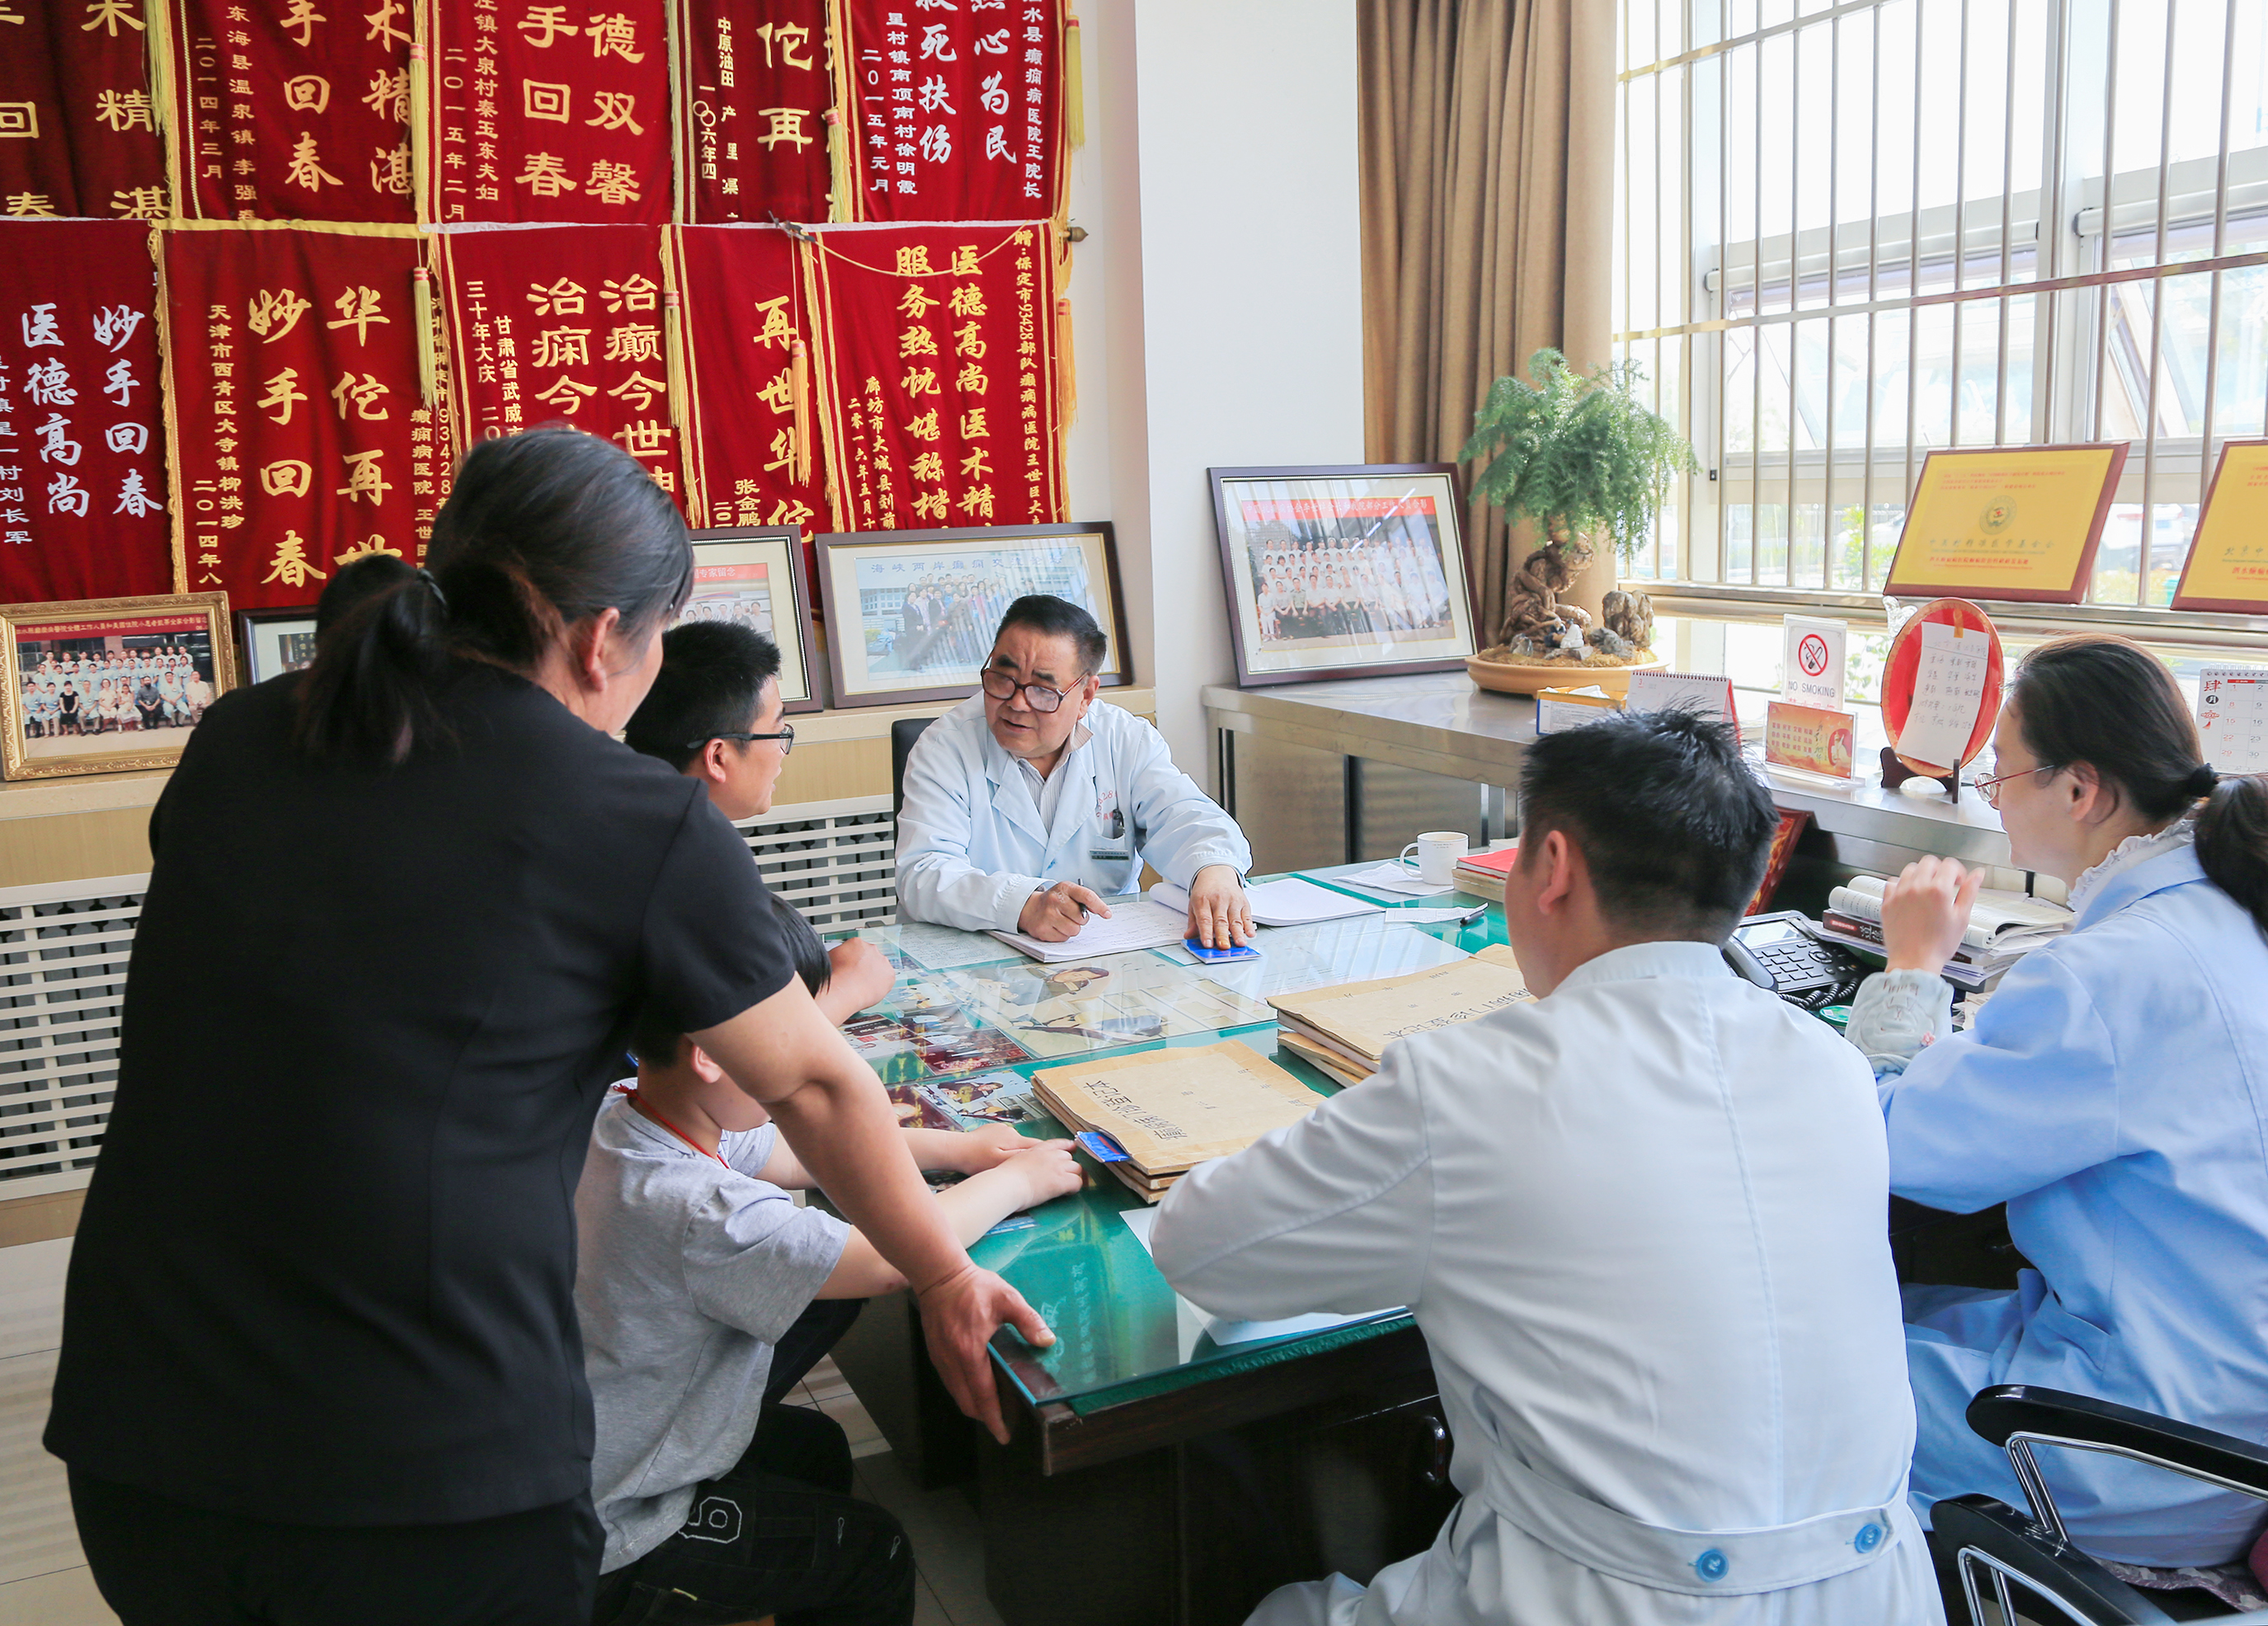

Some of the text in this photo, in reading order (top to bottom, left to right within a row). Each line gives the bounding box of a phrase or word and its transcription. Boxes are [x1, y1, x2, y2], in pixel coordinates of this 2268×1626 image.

[195, 38, 223, 178] 二〇一四年三月
[444, 48, 467, 220] 二〇一五年二月
[515, 6, 578, 197] 手回春
[585, 13, 645, 204] 德双馨
[756, 21, 813, 153] 佗再
[862, 49, 890, 192] 二〇一五年元月
[1022, 0, 1044, 199] 水县癫痫病医院王院长
[22, 303, 90, 518] 医德高尚
[93, 305, 162, 518] 妙手回春
[248, 289, 327, 587] 妙手回春
[526, 277, 597, 436] 治痫今
[896, 245, 950, 528] 服务热忱堪称楷
[948, 245, 995, 526] 医德高尚医术精
[192, 480, 223, 585] 二〇一四年八
[1788, 681, 1835, 698] NO SMOKING
